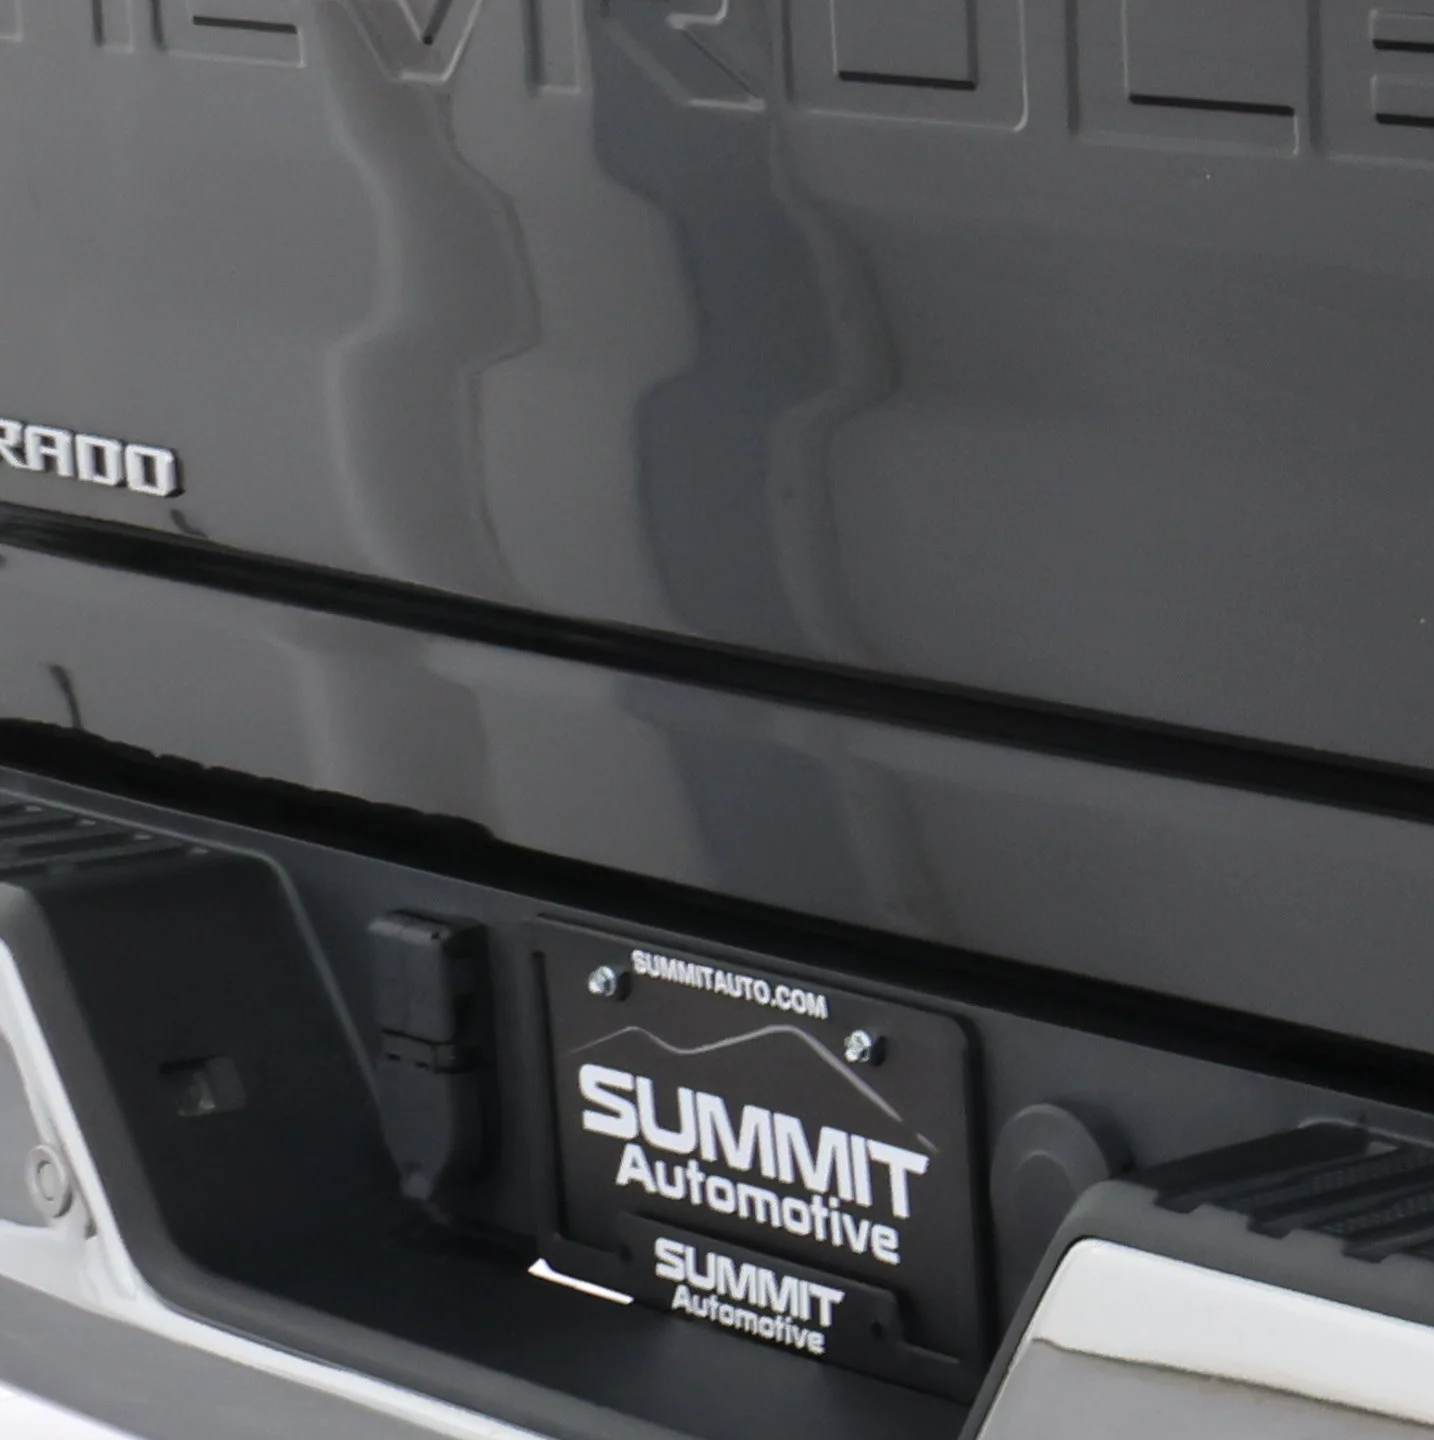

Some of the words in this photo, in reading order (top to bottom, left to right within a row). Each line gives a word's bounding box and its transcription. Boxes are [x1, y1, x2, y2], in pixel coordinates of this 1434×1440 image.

[631, 949, 829, 1020] SUMMITAUTO.COM
[578, 1064, 930, 1219] SUMMIT
[616, 1143, 900, 1265] Automotive
[653, 1237, 845, 1327] SUMMIT
[671, 1283, 825, 1355] Automotive
